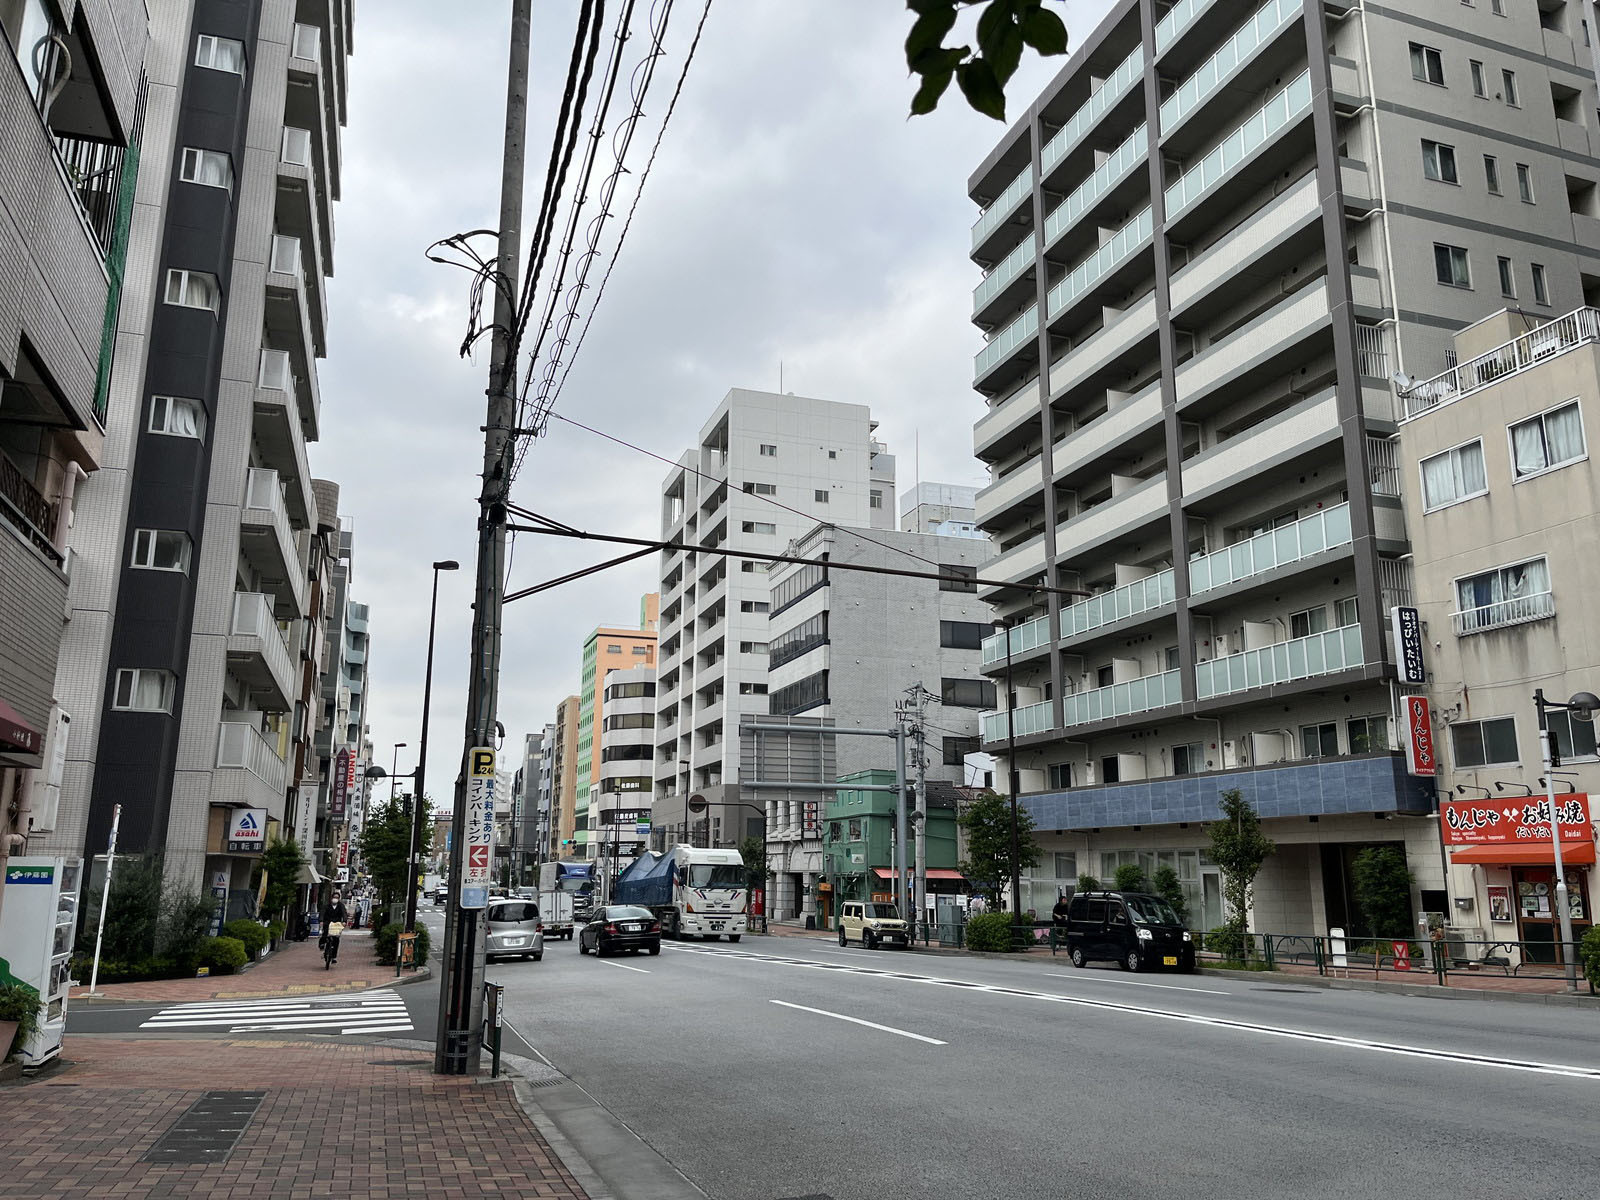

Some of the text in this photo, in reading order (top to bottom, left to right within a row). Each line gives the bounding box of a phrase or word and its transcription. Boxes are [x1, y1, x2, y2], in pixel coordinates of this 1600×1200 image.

[1402, 611, 1417, 679] はっぴいたいむ
[1413, 700, 1430, 766] もんじゃ
[347, 750, 356, 788] JANOME
[473, 752, 493, 775] P
[468, 779, 483, 843] コインパーキング
[483, 779, 494, 843] 最大料金あり
[1446, 806, 1500, 829] もんじゃ
[1522, 800, 1585, 824] お好み焼
[1564, 830, 1582, 838] Daidai
[229, 842, 262, 851] 自転車
[24, 871, 49, 879] 伊藤園
